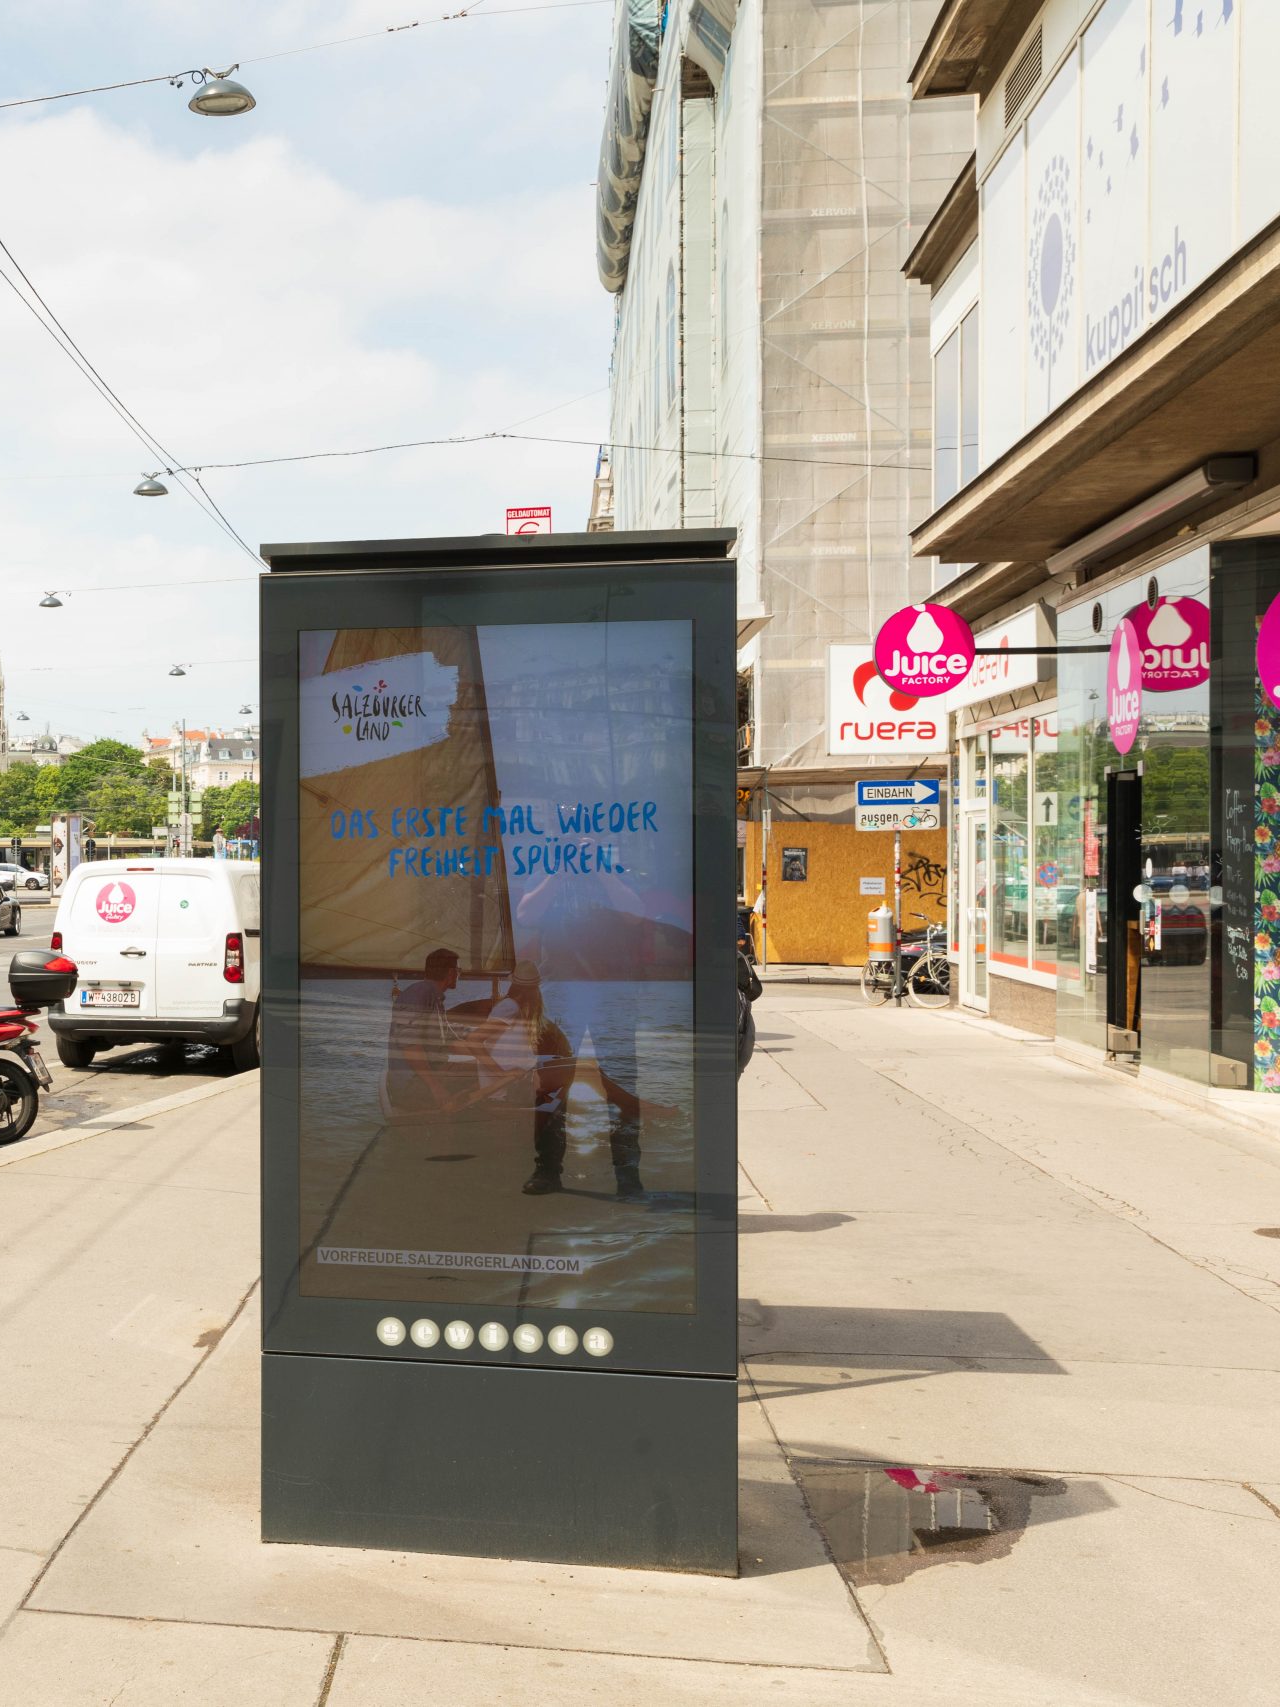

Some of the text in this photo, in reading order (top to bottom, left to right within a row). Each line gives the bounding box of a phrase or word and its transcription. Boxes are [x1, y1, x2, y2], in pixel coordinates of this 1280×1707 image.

[1085, 225, 1187, 371] kuppitsch
[507, 509, 550, 518] GELDAUTOMAT
[885, 650, 968, 676] Juice
[901, 676, 951, 685] FACTORY
[331, 693, 426, 723] SALZBURGER
[1110, 688, 1139, 726] Juice
[356, 720, 390, 741] LAND
[840, 721, 937, 740] ruefa
[1115, 724, 1133, 737] FACTORY
[867, 788, 913, 799] EINBAHN
[331, 810, 379, 840] DAS
[391, 805, 467, 838] ERSTE
[483, 805, 544, 835] MAL
[861, 813, 902, 825] ausgen.
[97, 901, 133, 914] Juice
[88, 992, 94, 1002] W
[320, 1248, 580, 1272] VORFREUDE.SALZBURGERLAND.COM
[380, 1322, 609, 1354] gewista
